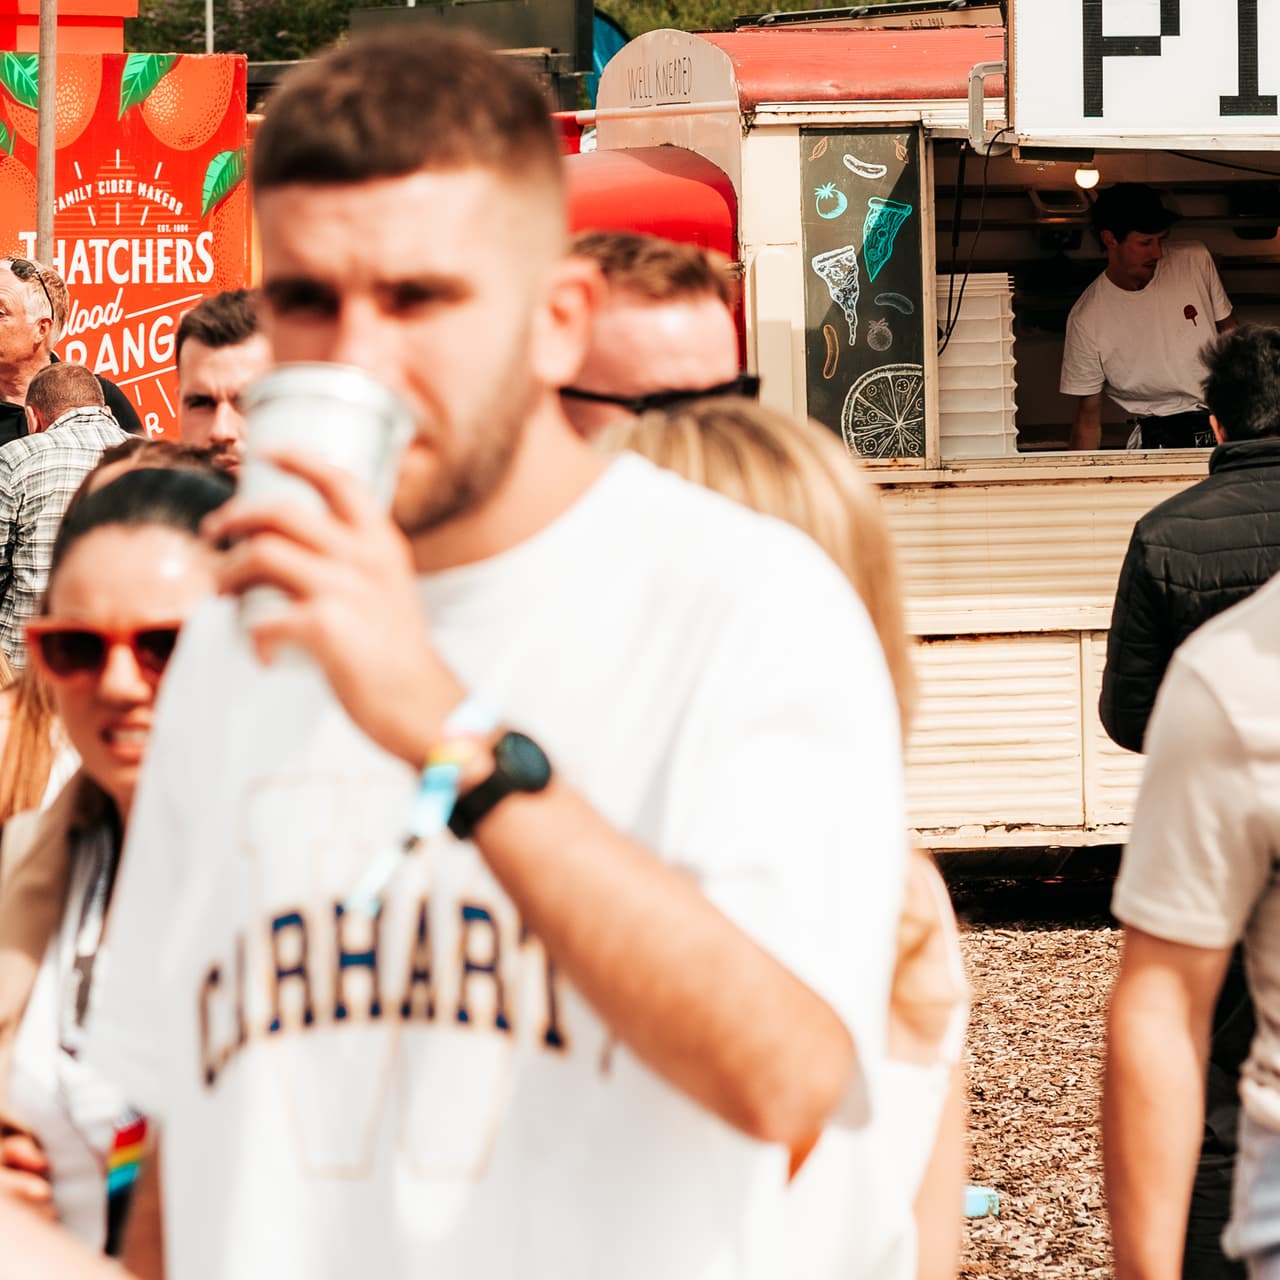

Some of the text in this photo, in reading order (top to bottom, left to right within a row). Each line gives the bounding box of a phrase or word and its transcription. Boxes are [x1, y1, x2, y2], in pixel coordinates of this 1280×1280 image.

[627, 64, 652, 101] WELL
[98, 179, 133, 195] CIDER
[138, 182, 183, 215] MAKERS
[59, 287, 124, 341] lood
[56, 310, 190, 376] RANG
